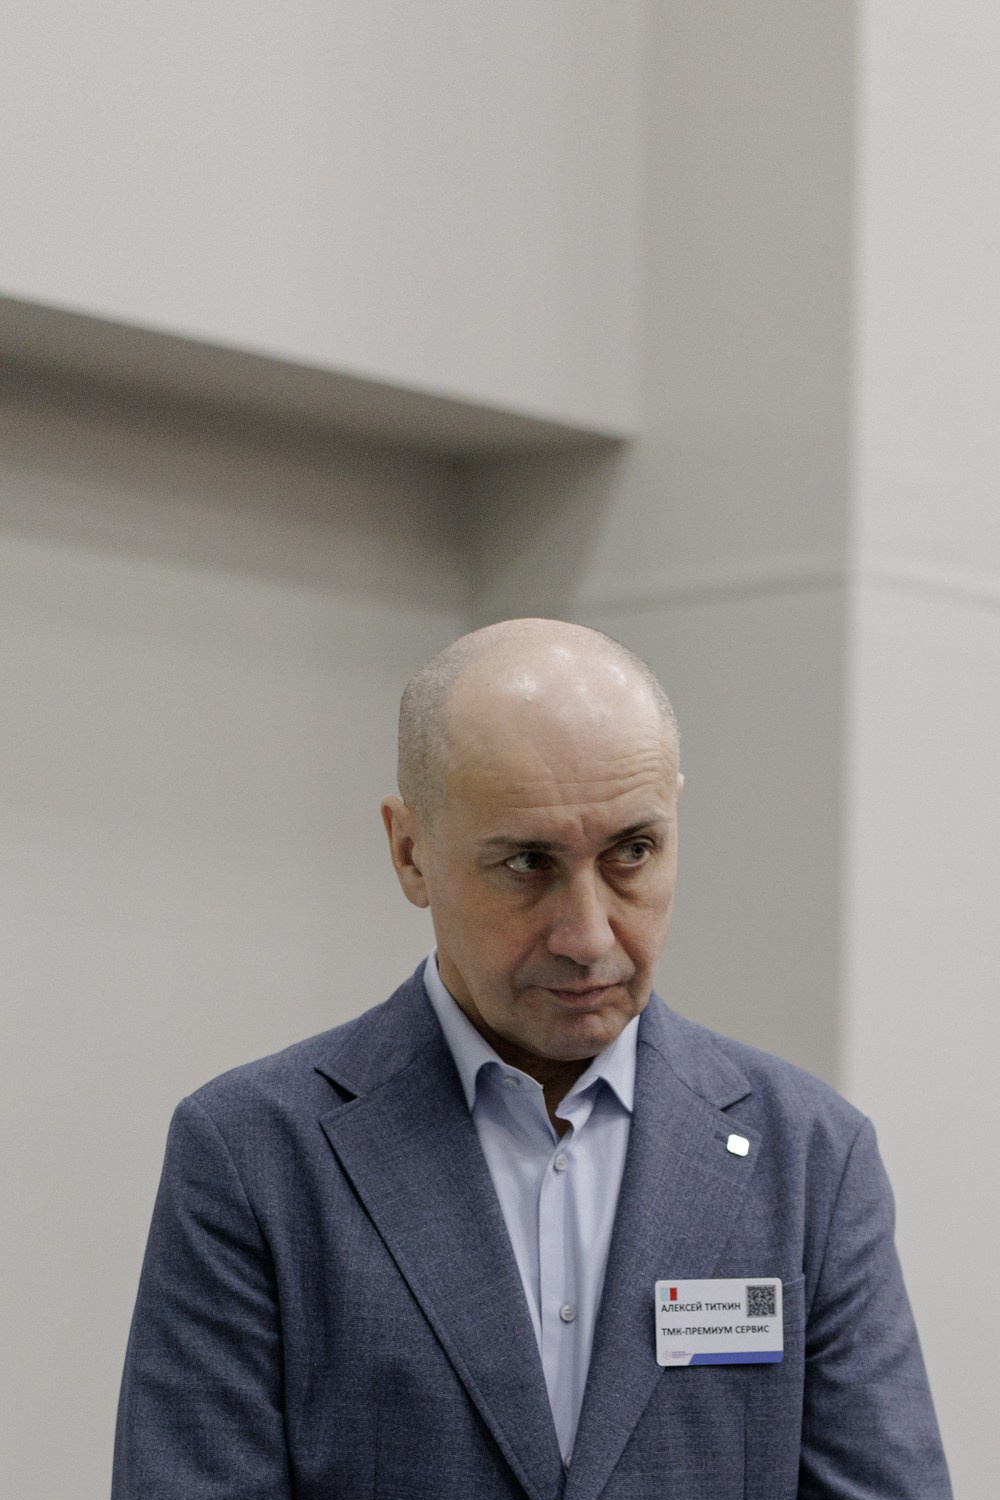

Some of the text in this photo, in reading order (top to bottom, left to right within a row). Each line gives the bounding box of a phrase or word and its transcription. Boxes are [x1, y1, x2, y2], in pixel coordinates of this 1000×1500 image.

[661, 1301, 741, 1312] АЛЕКСЕЙ ТИТКИН
[662, 1325, 769, 1336] ТМК-ПРЕМИУМ СЕРВИС
